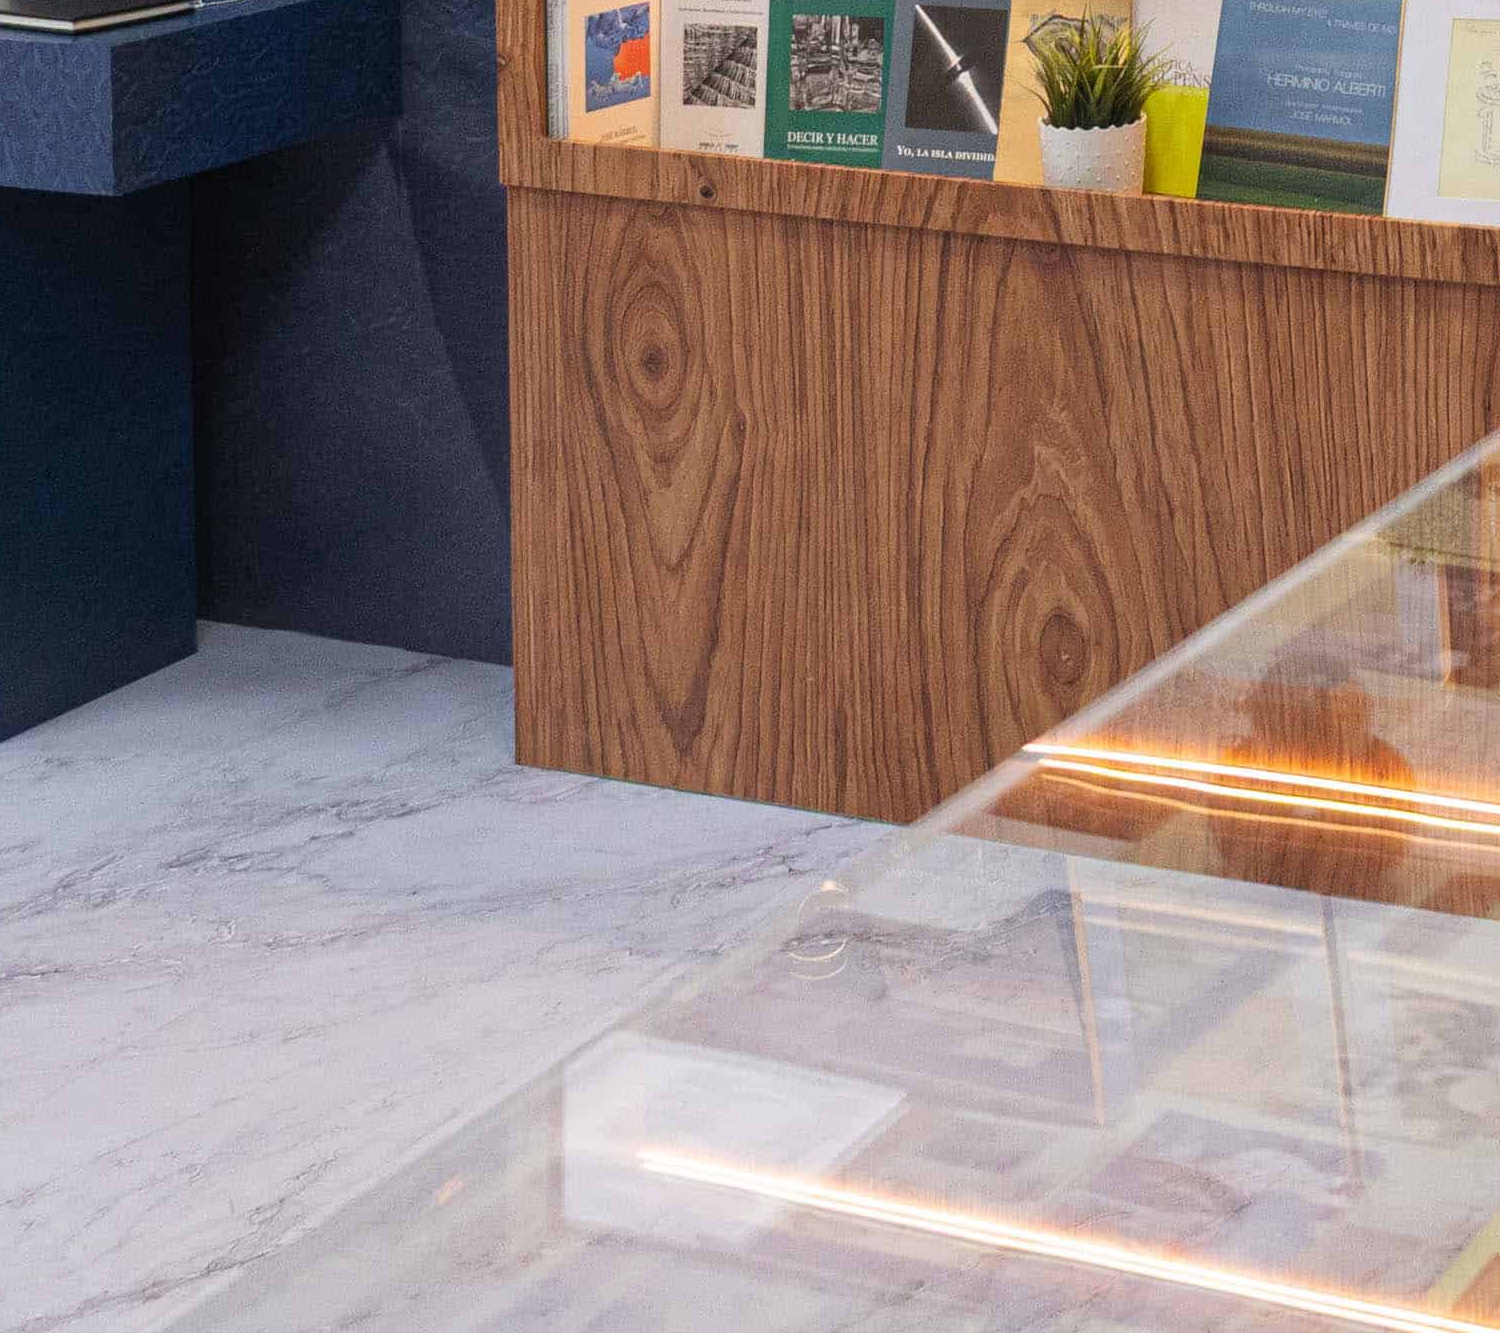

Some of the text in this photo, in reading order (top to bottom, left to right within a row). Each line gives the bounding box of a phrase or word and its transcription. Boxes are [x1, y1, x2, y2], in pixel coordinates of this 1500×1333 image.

[1332, 78, 1387, 99] ALBERTI
[787, 131, 878, 146] DECIR Y HACER
[931, 149, 954, 160] ISLA
